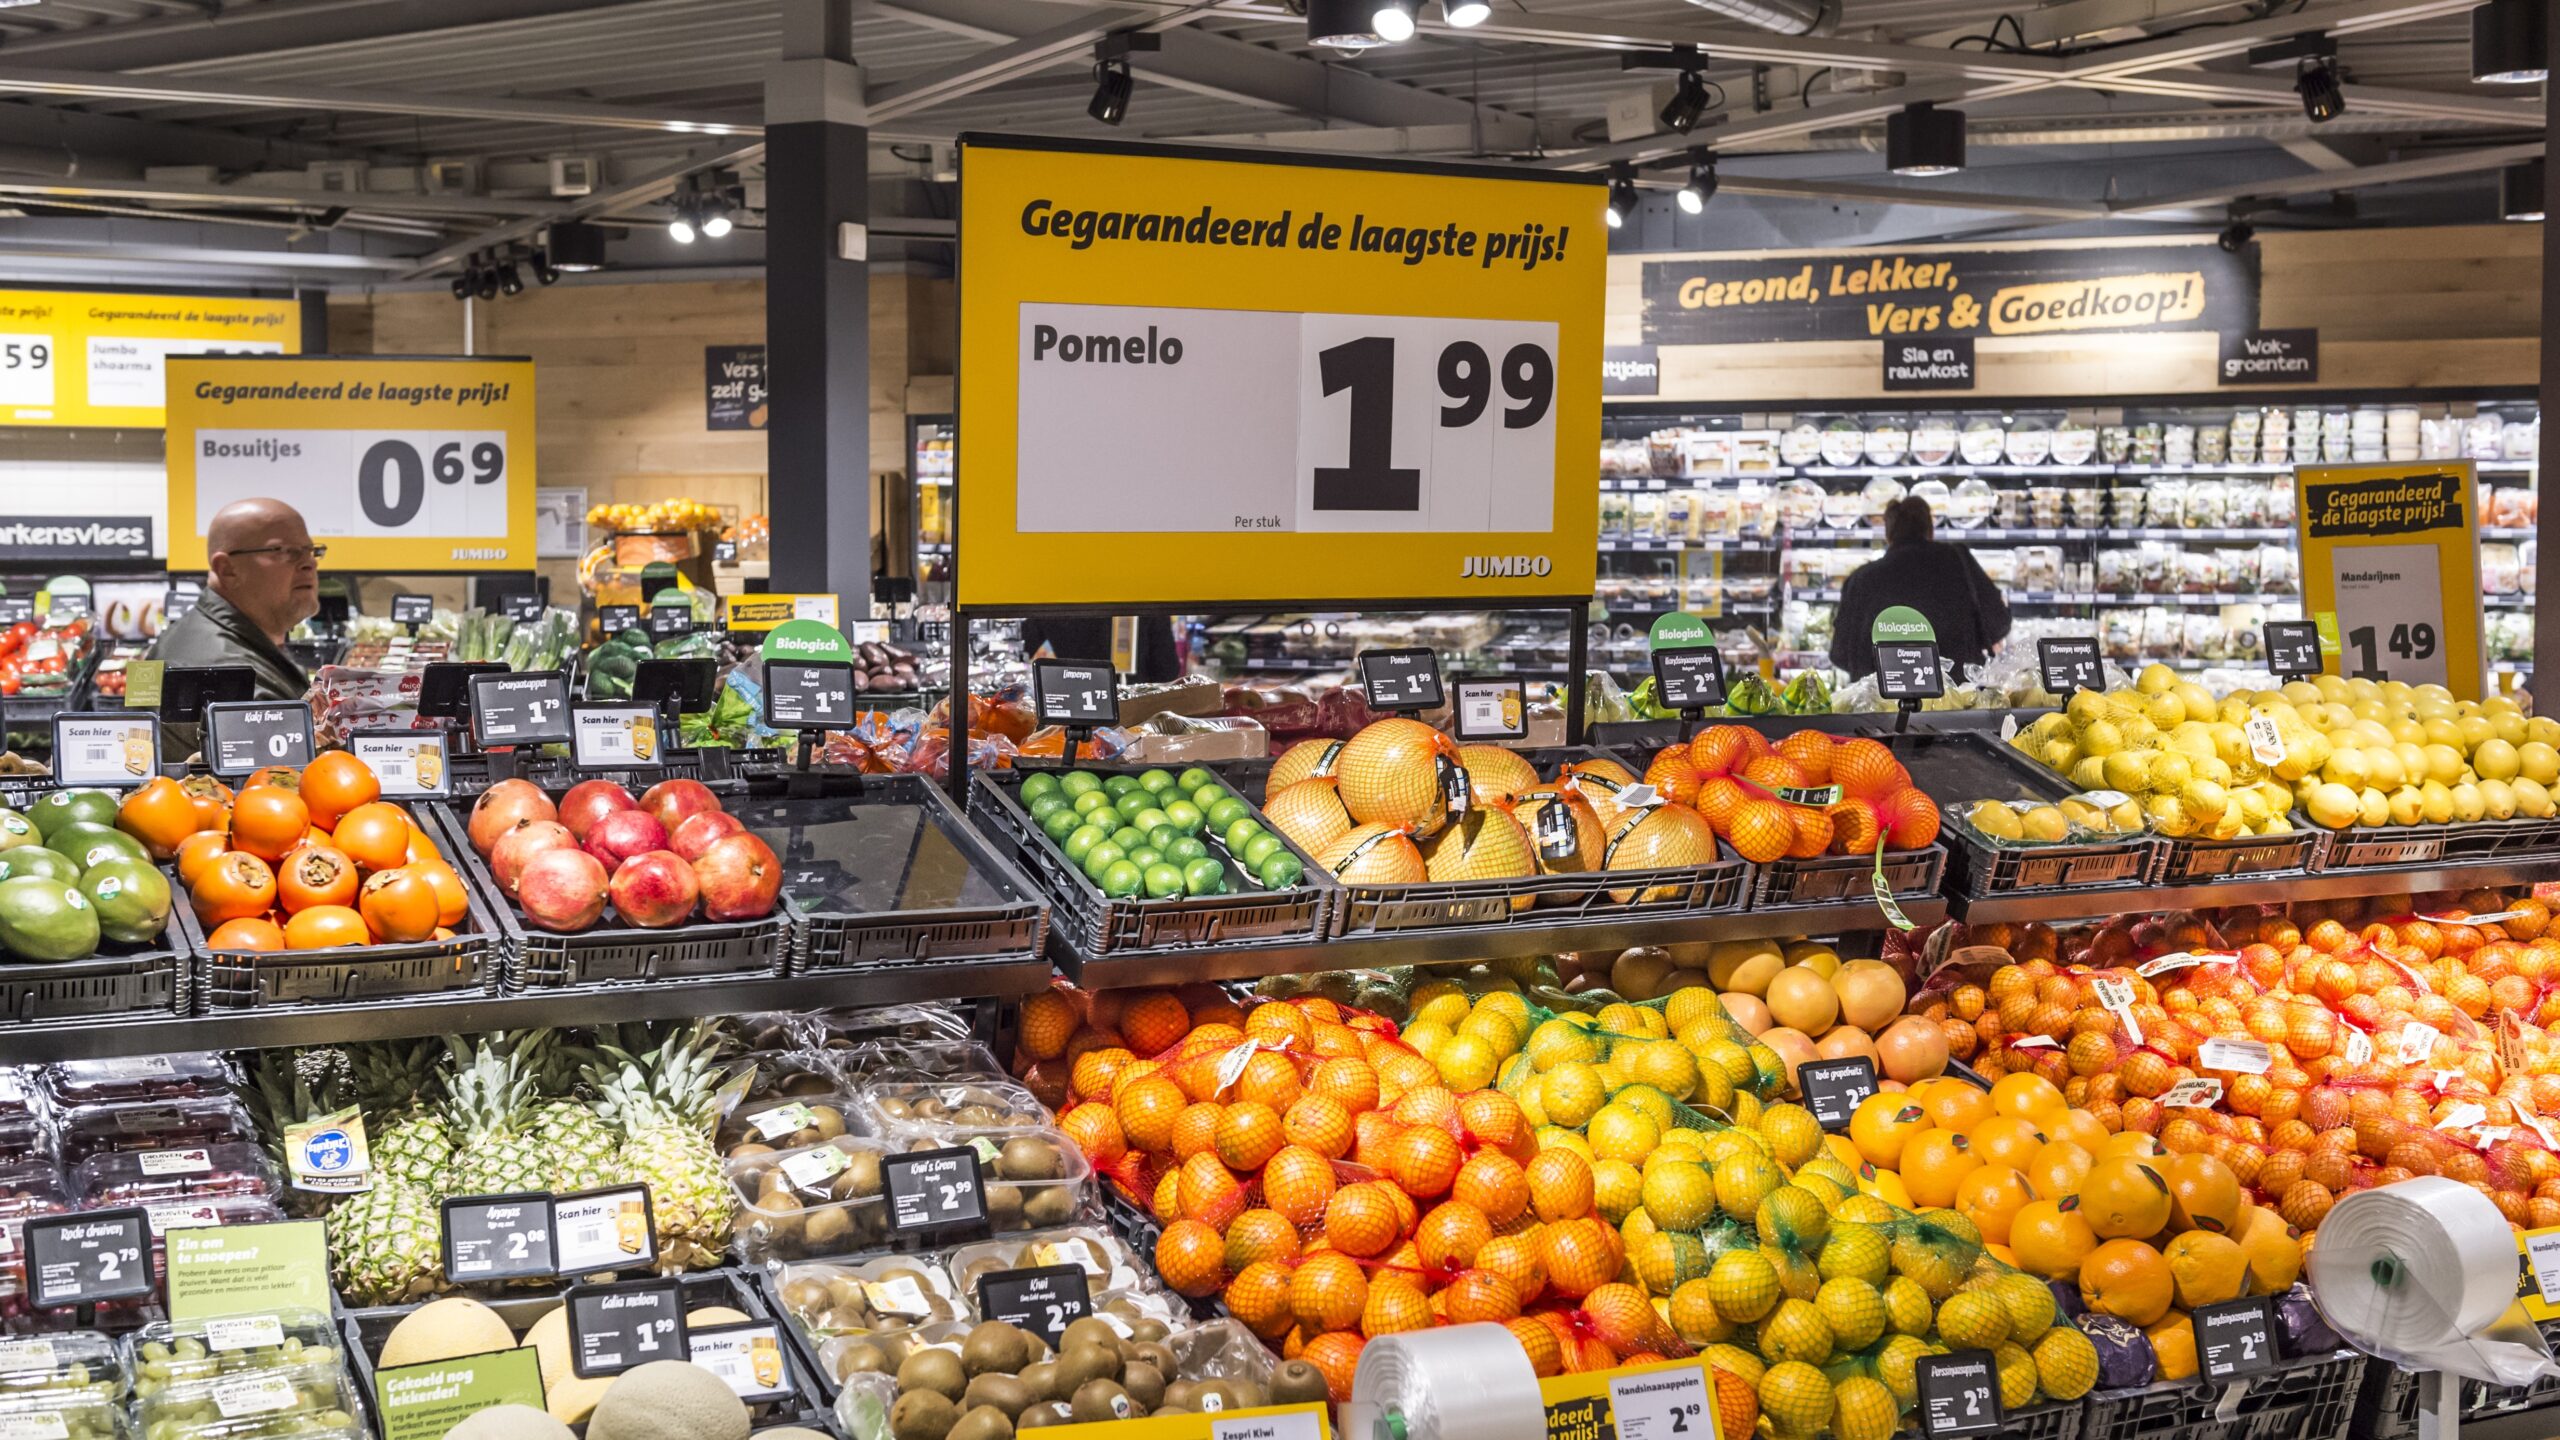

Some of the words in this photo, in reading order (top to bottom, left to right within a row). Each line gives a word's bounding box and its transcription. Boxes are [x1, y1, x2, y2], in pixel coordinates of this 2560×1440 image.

[1021, 199, 1291, 250] Gegarandeerd
[1298, 213, 1341, 251] de
[1350, 214, 1475, 265] laagste
[1482, 225, 1569, 271] prijs!
[1679, 265, 1818, 309] Gezond,
[1829, 257, 1958, 296] Lekker,
[88, 306, 180, 322] Gegarandeerd
[1868, 302, 1940, 335] Vers
[1949, 294, 1980, 328] &
[1999, 279, 2192, 323] Goedkoop!
[1033, 325, 1183, 365] Pomelo
[2244, 338, 2291, 355] Wok-
[1902, 347, 1929, 363] Sla
[1932, 349, 1955, 362] en
[722, 361, 759, 378] Vers
[1888, 362, 1969, 379] rauwkost
[2225, 355, 2309, 377] groenten
[196, 381, 343, 403] Gegarandeerd
[347, 383, 372, 400] de
[378, 383, 453, 404] laagste
[457, 383, 510, 406] prijs!
[711, 380, 745, 399] zelf
[203, 440, 301, 462] Bosuitjes
[2327, 481, 2442, 511] Gegarandeerd
[1234, 515, 1254, 528] Per
[1256, 515, 1281, 528] stuk
[2321, 508, 2341, 526] de
[2344, 505, 2401, 528] laagste
[2404, 501, 2446, 524] prijs!
[450, 547, 508, 561] JUMBO
[1459, 555, 1551, 578] JUMBO
[2341, 571, 2401, 584] Mandarijnen
[1658, 627, 1704, 641] Biologisch
[1878, 622, 1928, 635] Biologisch
[776, 637, 839, 654] Biologisch
[1390, 655, 1411, 665] Pomelo
[1464, 689, 1479, 698] Scan
[1480, 689, 1493, 697] hier
[264, 711, 284, 721] fruit
[583, 716, 602, 725] Scan
[604, 716, 619, 725] hier
[68, 727, 91, 737] Scan
[94, 727, 112, 737] hier
[363, 744, 385, 753] Scan
[387, 743, 403, 753] hier
[558, 1210, 580, 1220] Scan
[582, 1206, 602, 1217] hier
[61, 1225, 85, 1241] Rode
[86, 1222, 124, 1239] druiven
[177, 1238, 198, 1250] Zin
[201, 1238, 224, 1249] om
[177, 1253, 192, 1264] te
[195, 1247, 259, 1264] snoepen?
[178, 1279, 207, 1287] druiven.
[179, 1288, 213, 1298] gezonder
[226, 1284, 258, 1292] minstens
[271, 1281, 295, 1289] lekker!
[1030, 1277, 1048, 1291] Kiwi
[601, 1294, 624, 1310] Galia
[625, 1292, 659, 1308] meloen
[713, 1340, 734, 1351] hier
[386, 1371, 444, 1393] Gekoeld
[447, 1369, 474, 1385] nog
[1618, 1378, 1699, 1396] Handsinaasappelen
[389, 1384, 460, 1408] lekkerder!
[391, 1412, 403, 1422] Leg
[406, 1410, 415, 1419] de
[417, 1405, 463, 1419] galiameloen
[465, 1402, 482, 1410] even
[484, 1399, 493, 1407] in
[393, 1421, 423, 1432] koelkast
[425, 1418, 442, 1427] voor
[444, 1415, 457, 1424] een
[1222, 1429, 1251, 1440] Zespri
[1253, 1427, 1274, 1438] Kiwi
